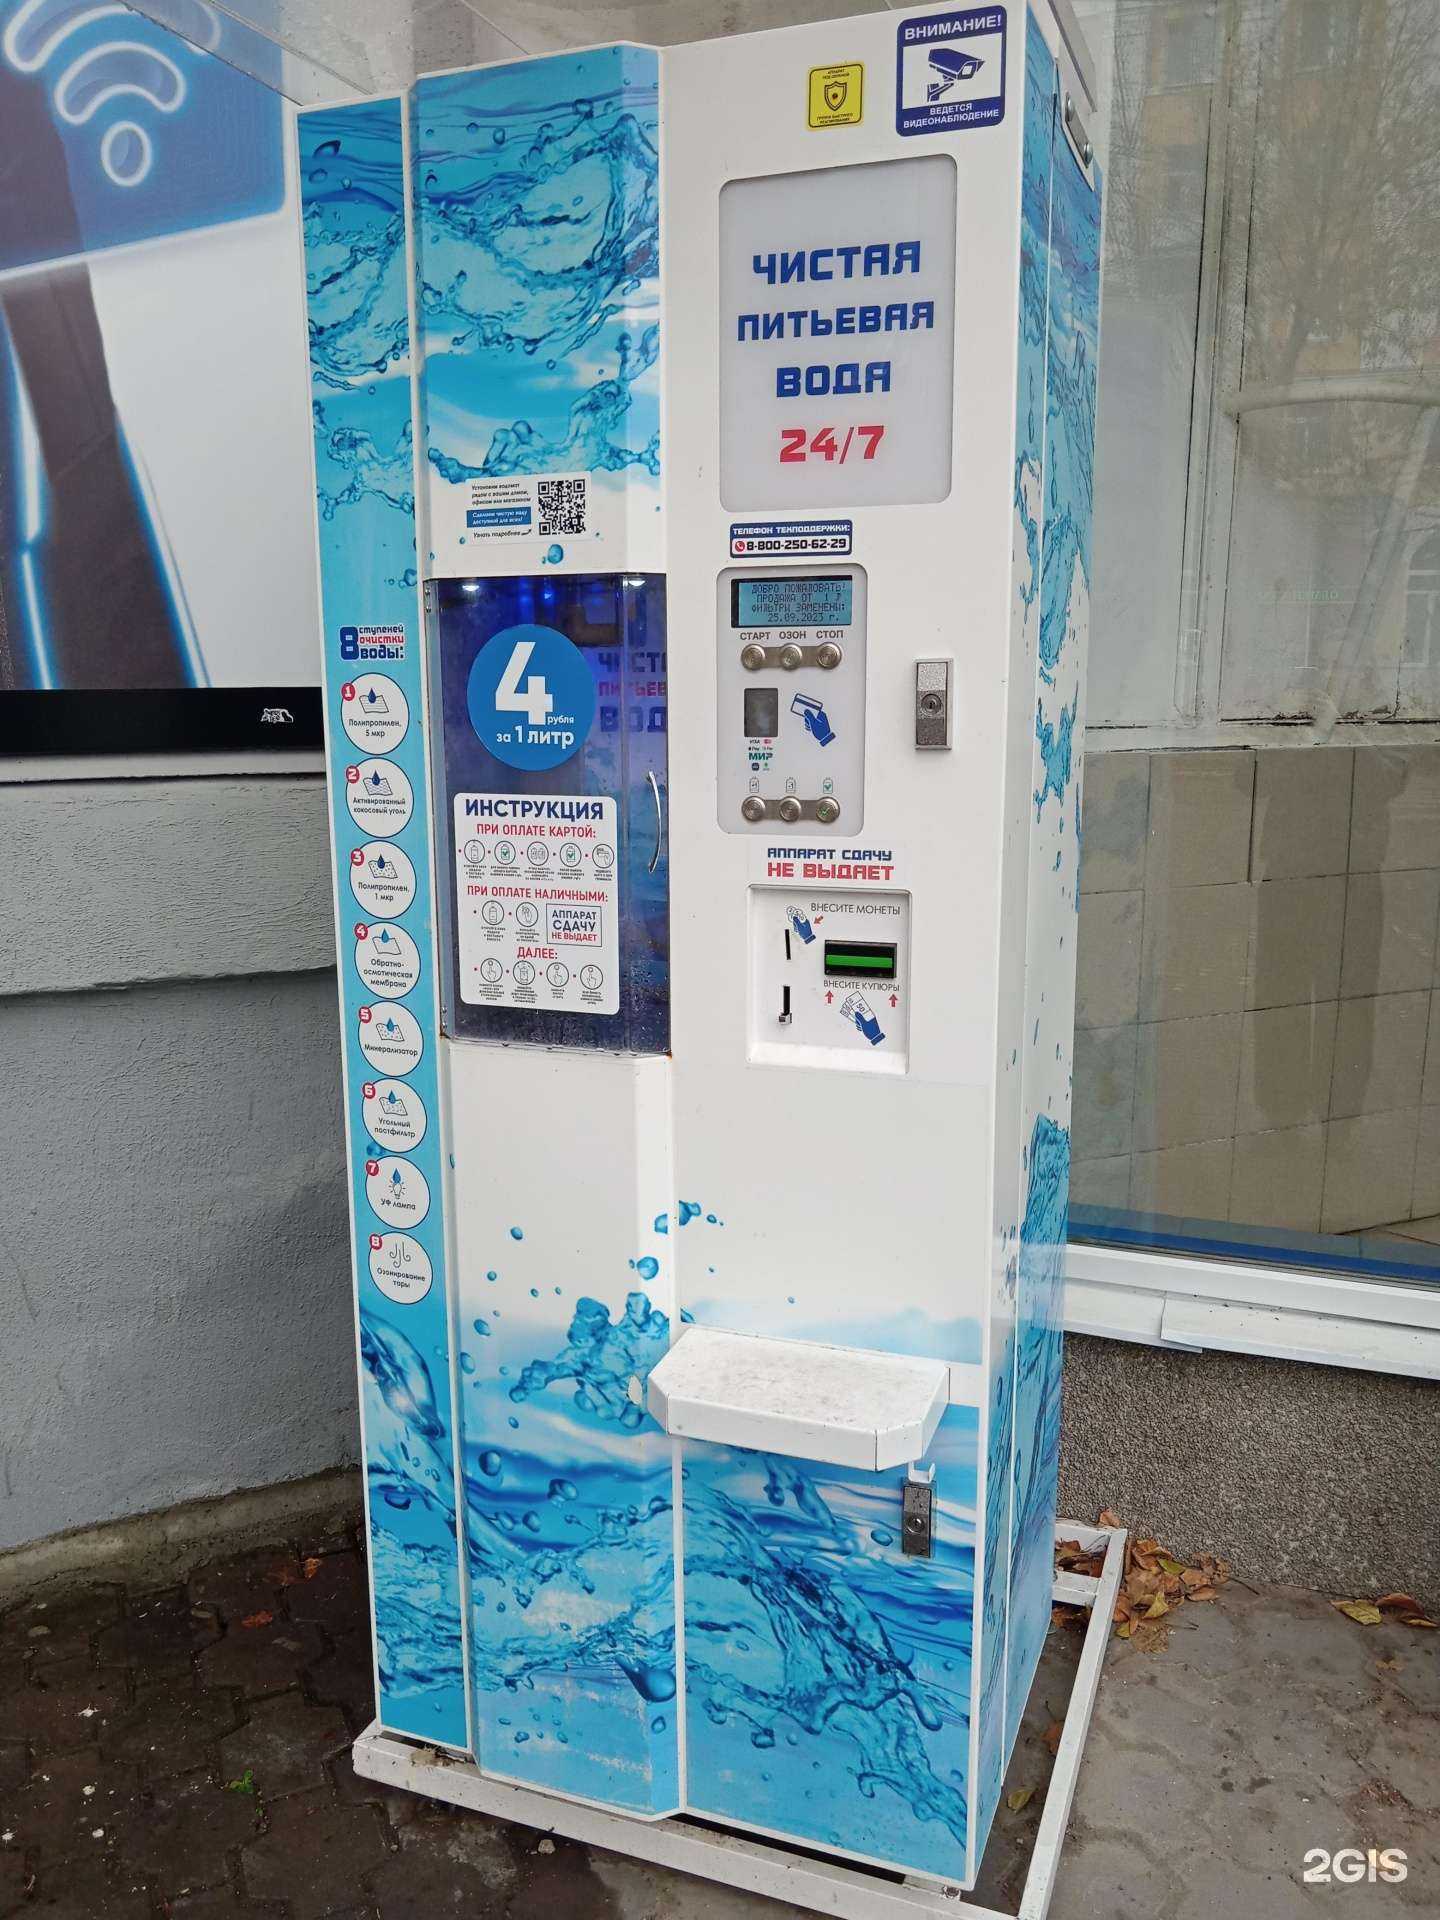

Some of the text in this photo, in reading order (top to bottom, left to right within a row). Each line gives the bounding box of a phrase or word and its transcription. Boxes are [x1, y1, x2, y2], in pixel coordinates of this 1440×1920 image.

[904, 14, 1002, 41] ВНИМАНИЕ!
[929, 102, 973, 116] ВЕДЕТСЯ
[903, 109, 1000, 129] ВИДЕОНАБЛЮДЕНИЕ
[752, 240, 921, 285] ЧИСТАЯ
[737, 300, 935, 342] ПИТЬЕВАЯ
[776, 360, 892, 398] ВОДА
[779, 424, 885, 465] 24/7
[733, 524, 851, 536] ТЕЛЕФОН ТЕХПОДДЕРЖКИ:
[746, 538, 847, 551] 8-800-250-62-29
[340, 624, 404, 660] 8 ступеней
[359, 635, 404, 644] очистки
[739, 630, 844, 641] СТАРТ ОЗОН СТОП
[359, 645, 404, 660] воды:
[495, 641, 575, 726] 4 рубля
[495, 724, 575, 750] за 1 литр
[748, 752, 774, 761] МИР
[348, 768, 357, 780] 2
[353, 797, 406, 806] Активированный
[353, 806, 406, 816] кокосовый уголь
[465, 798, 604, 823] ИНСТРУКЦИЯ
[476, 823, 596, 839] ПРИ ОПЛАТЕ КАРТОЙ:
[767, 847, 893, 861] АППАРАТ СДАЧУ
[767, 862, 894, 881] НЕ ВЫДАЕТ
[380, 893, 394, 902] мкр
[467, 885, 609, 902] ПРИ ОПЛАТЕ НАЛИЧНЫМИ:
[551, 909, 598, 921] АППАРАТ
[810, 902, 901, 916] ВНЕСИТЕ МОНЕТЫ
[357, 926, 365, 938] 4
[553, 920, 597, 932] СДАЧУ
[551, 932, 563, 941] НЕ
[563, 933, 598, 943] ВЫДАЕТ
[516, 946, 559, 960] ДАЛЕЕ:
[370, 958, 405, 969] Обратно-
[363, 969, 413, 979] осмотическая
[370, 979, 407, 989] мембрана
[823, 979, 900, 992] ВНЕСИТЕ КУПЮРЫ
[361, 1009, 370, 1021] 5
[364, 1043, 419, 1057] Минерализатор
[378, 1117, 411, 1128] Угольный
[374, 1126, 416, 1139] постфильтр
[368, 1163, 376, 1173] 7
[380, 1197, 416, 1211] УФ лампа
[376, 1266, 426, 1282] Озонирование
[392, 1279, 411, 1289] тары
